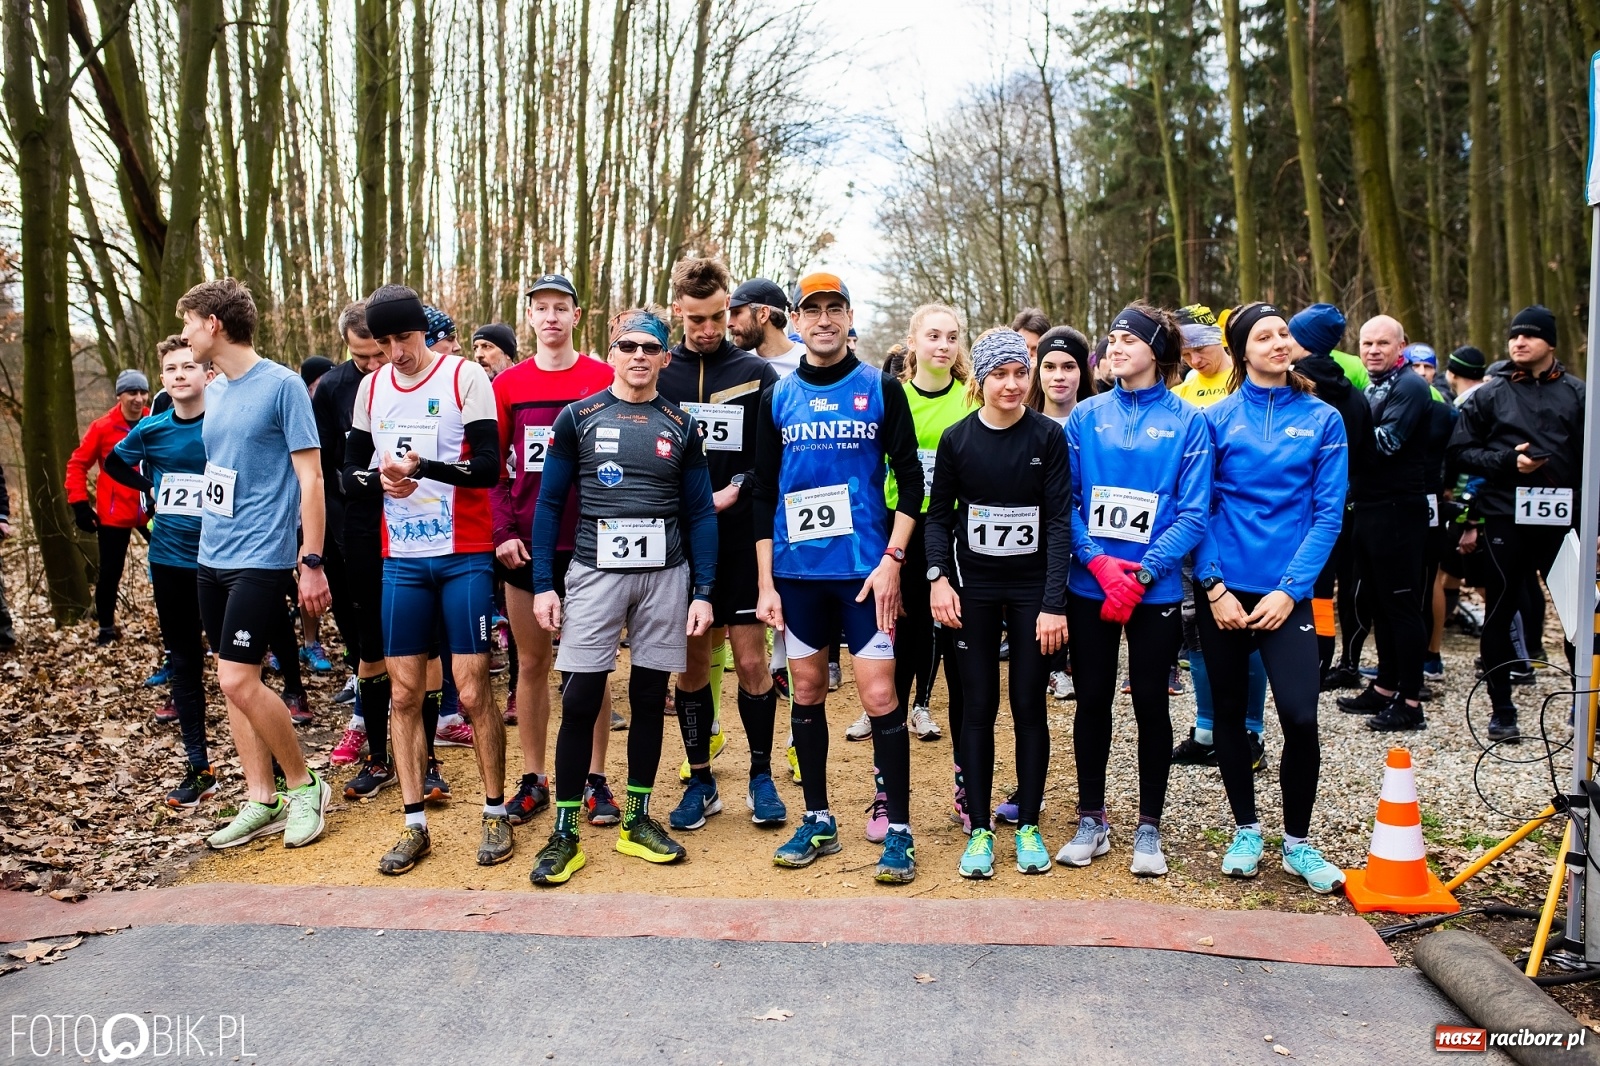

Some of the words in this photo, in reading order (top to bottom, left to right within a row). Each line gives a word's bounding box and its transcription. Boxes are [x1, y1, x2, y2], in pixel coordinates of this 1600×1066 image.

[781, 420, 878, 445] RUNNERS
[792, 443, 834, 453] EKO-OKNA
[836, 442, 860, 450] TEAM
[161, 488, 203, 508] 121
[206, 481, 224, 505] 49
[798, 505, 835, 532] 29
[1093, 504, 1150, 534] 104
[1521, 500, 1568, 518] 156
[973, 523, 1035, 547] 173
[612, 536, 648, 559] 31
